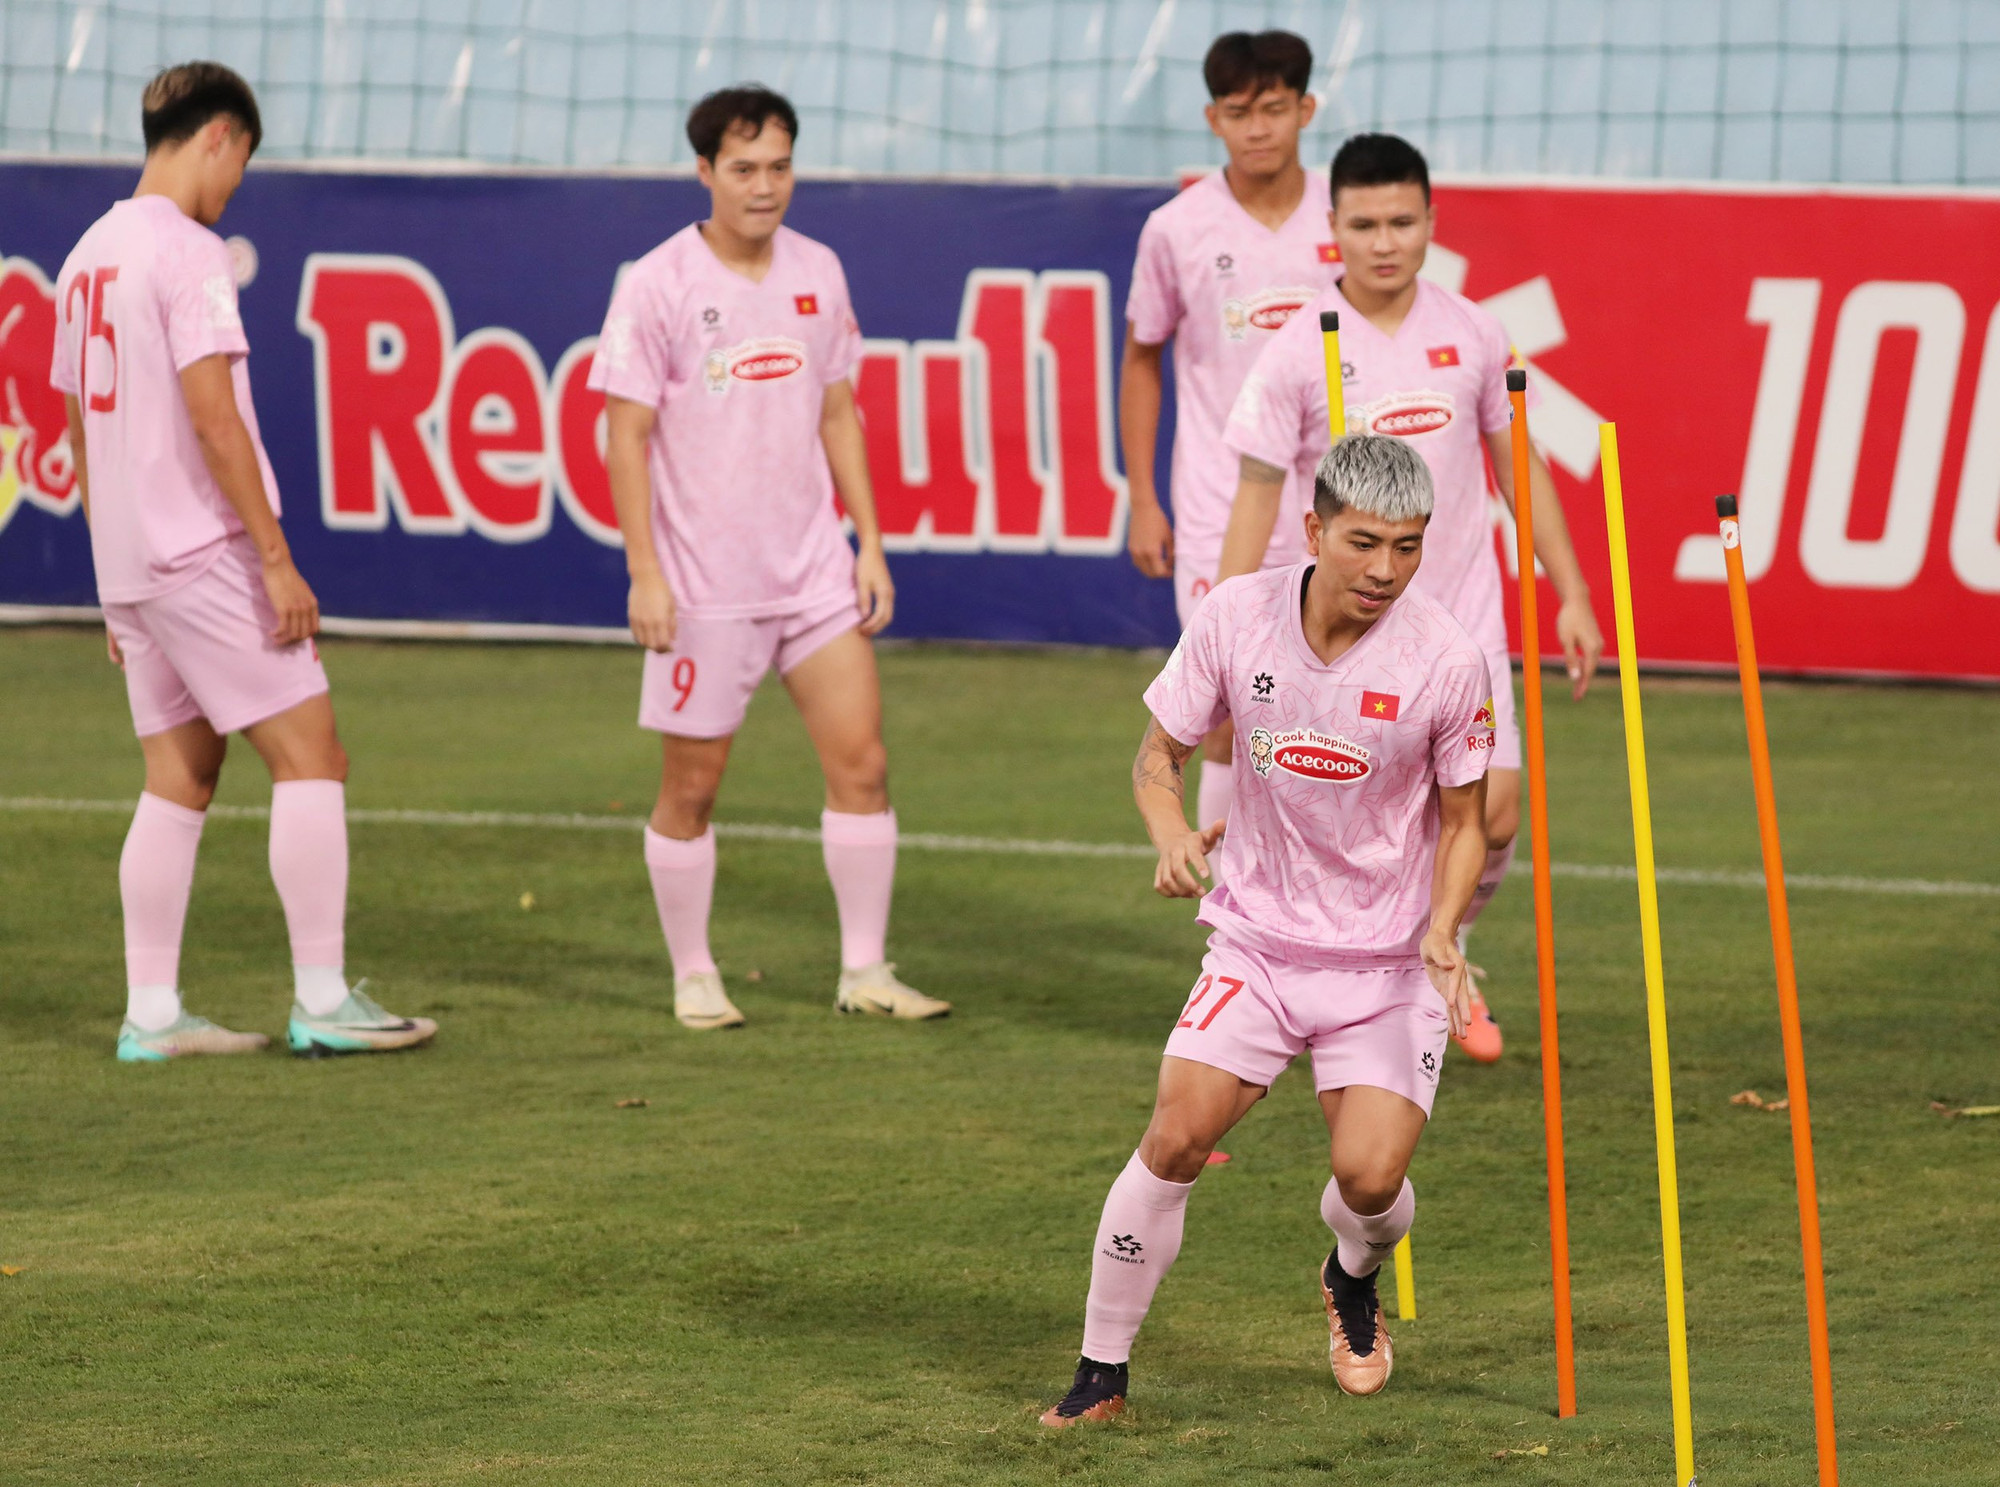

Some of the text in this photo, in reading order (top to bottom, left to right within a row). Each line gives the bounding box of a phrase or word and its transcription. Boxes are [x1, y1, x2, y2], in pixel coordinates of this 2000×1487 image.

[842, 268, 1131, 556] ull
[672, 657, 696, 712] 9
[1274, 731, 1369, 759] Cook happiness
[1466, 730, 1496, 751] Red
[1175, 973, 1245, 1031] 27
